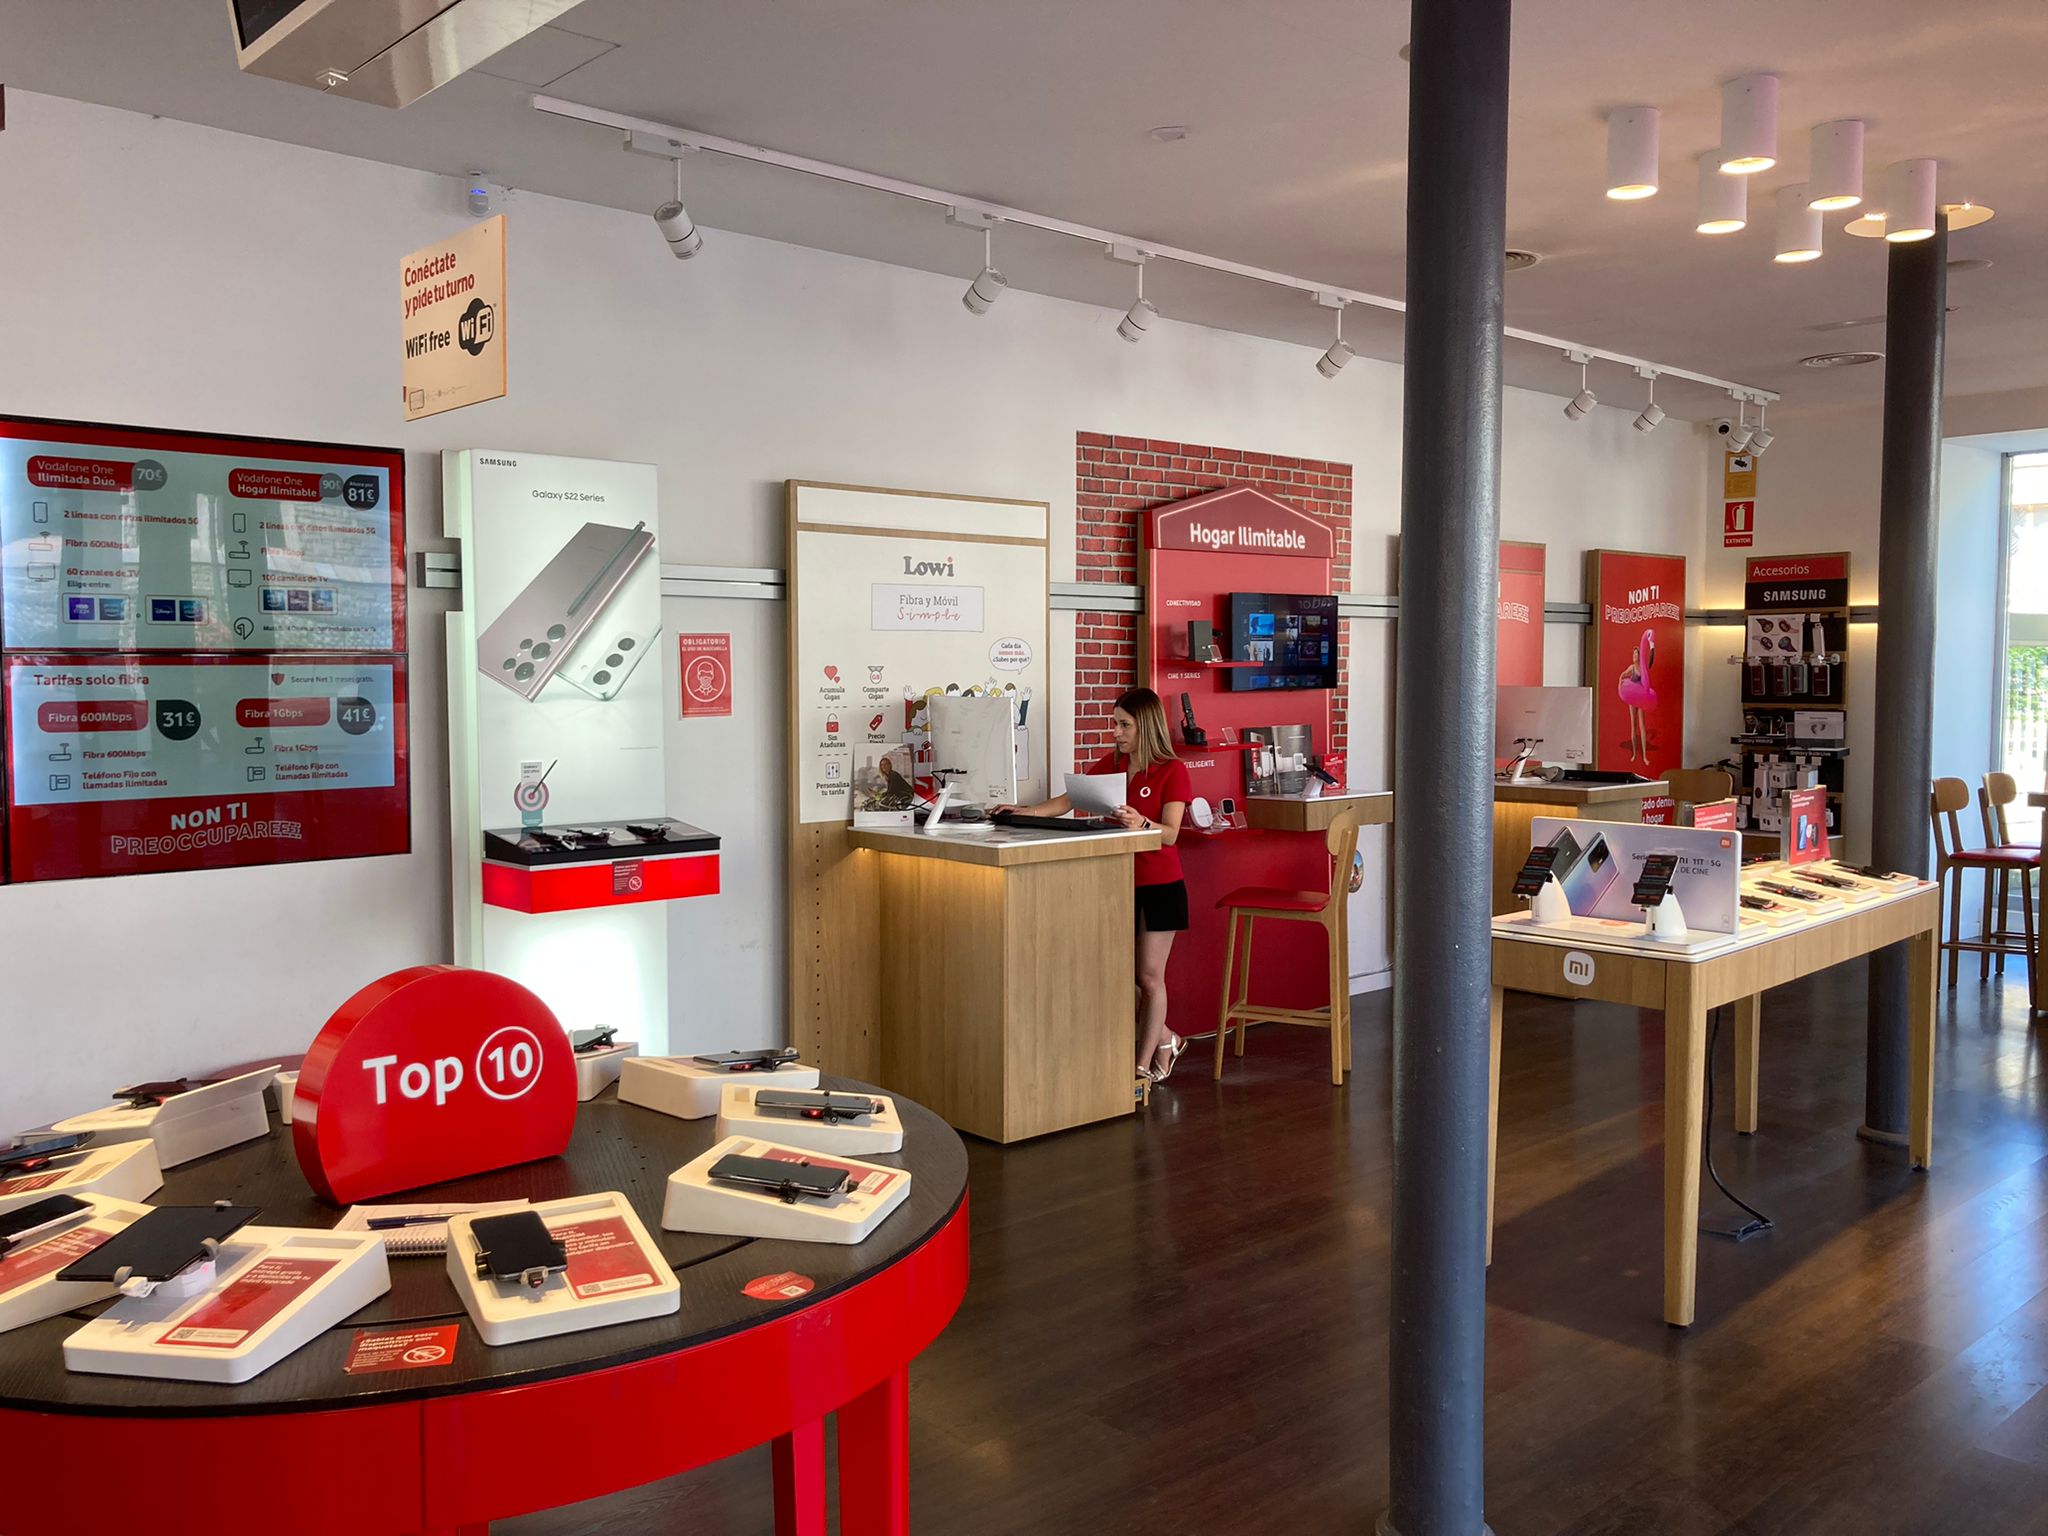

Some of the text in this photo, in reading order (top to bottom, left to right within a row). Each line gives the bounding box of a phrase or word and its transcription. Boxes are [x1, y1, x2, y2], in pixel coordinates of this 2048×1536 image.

[404, 252, 456, 287] Conéctate
[405, 273, 475, 319] y pide tu turno
[405, 330, 451, 360] WiFi free
[37, 460, 114, 475] Vodafone One
[479, 457, 517, 467] SAMSUNG
[38, 472, 116, 487] Ilimitada Dúo
[136, 467, 163, 482] 70€
[237, 472, 303, 486] Vodafone One
[237, 484, 317, 498] Hogar Ilimitable
[348, 488, 375, 502] 81€
[532, 489, 605, 503] Galaxy S22 Series
[64, 510, 70, 518] 2
[144, 513, 186, 525] ilimitados
[1190, 522, 1306, 549] Hogar Ilimitable
[65, 539, 88, 548] Fibra
[66, 568, 78, 576] 60
[79, 568, 114, 577] canales
[903, 555, 955, 577] Lowi
[1752, 563, 1810, 577] Accesorios
[900, 594, 959, 608] Fibra y Móvil
[1628, 585, 1660, 604] NON TI
[1763, 588, 1826, 602] SAMSUNG
[33, 673, 149, 686] Tarifas solo fibra
[48, 711, 133, 724] Fibra 600Mbps
[162, 711, 195, 728] 31€
[245, 708, 304, 720] Fibra 1Gbps
[342, 707, 371, 723] 41€
[819, 741, 846, 749] Ataduras
[83, 750, 146, 760] Fibra 600Mbps
[275, 763, 308, 772] Teléfono
[325, 762, 339, 770] con
[1184, 759, 1215, 769] TELIGENTE
[82, 770, 157, 780] Teléfono Fijo con
[82, 778, 168, 790] llamadas ilimitadas
[816, 782, 850, 790] Personaliza
[171, 802, 248, 830] NON TI
[1646, 813, 1664, 824] hogar
[1680, 866, 1710, 876] DE CINE
[362, 1041, 534, 1107] Top 10
